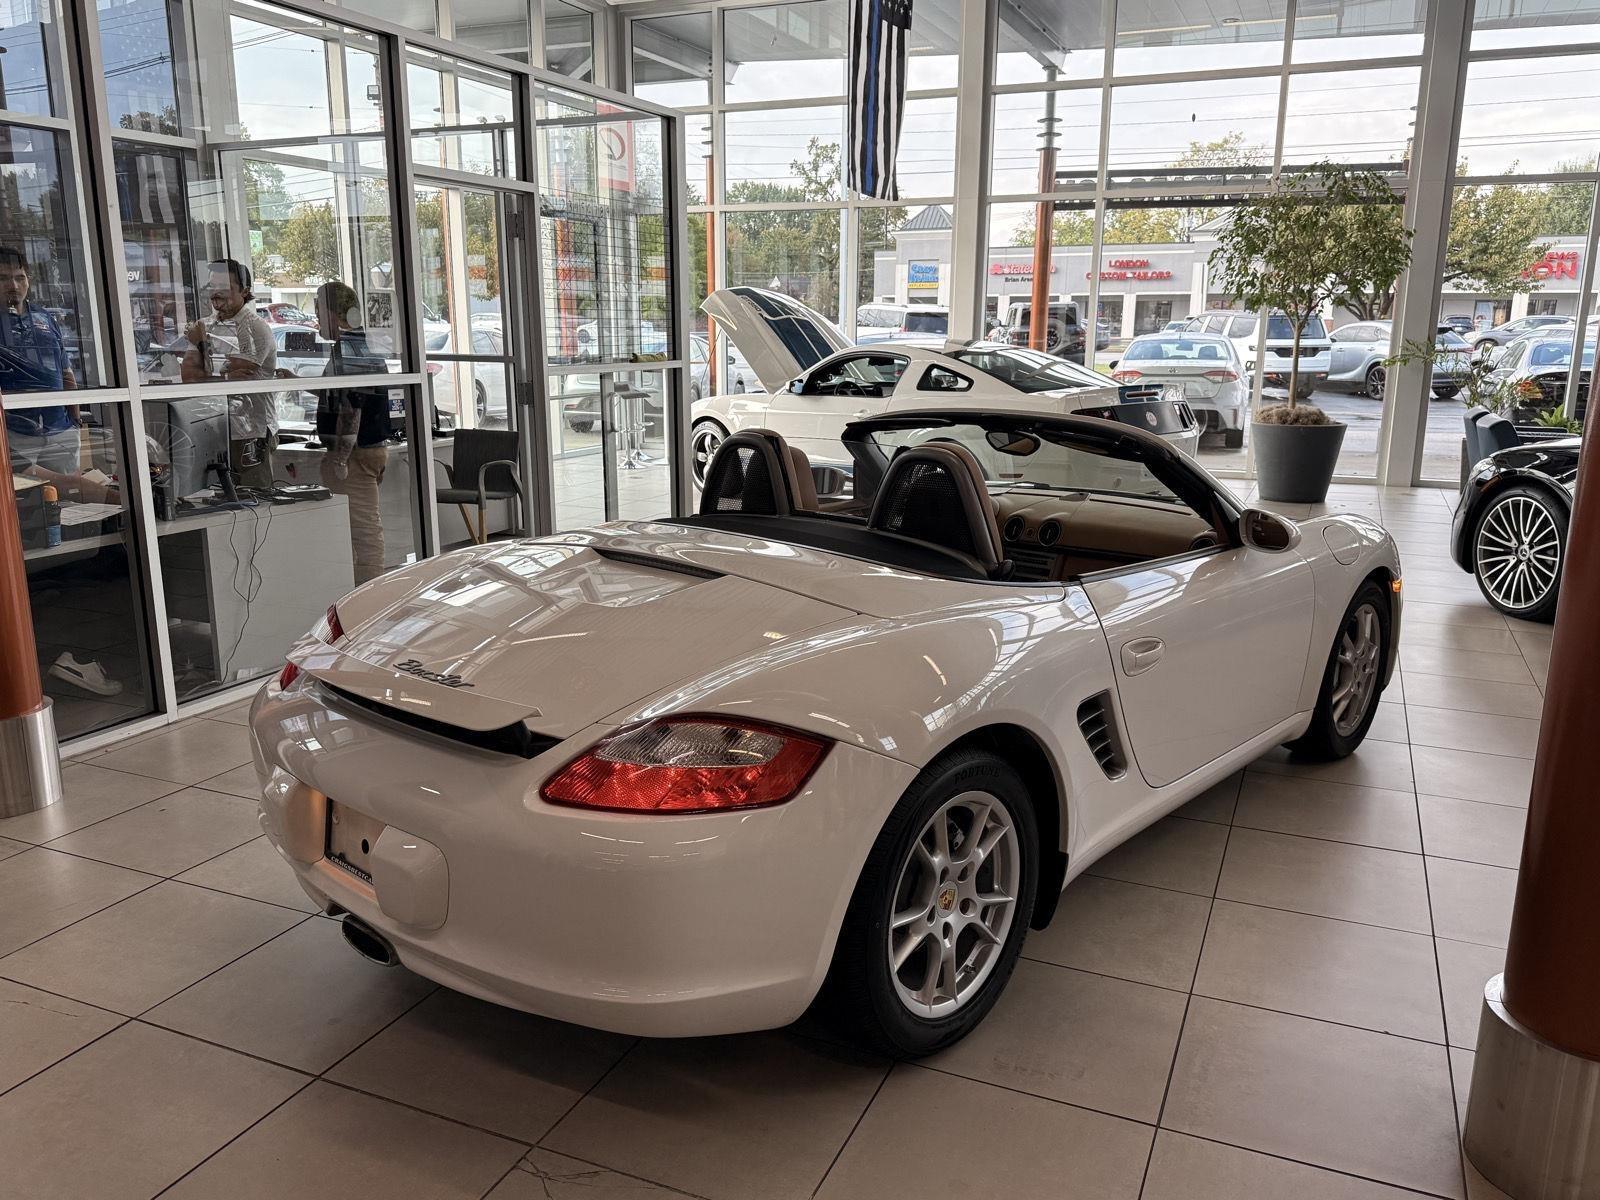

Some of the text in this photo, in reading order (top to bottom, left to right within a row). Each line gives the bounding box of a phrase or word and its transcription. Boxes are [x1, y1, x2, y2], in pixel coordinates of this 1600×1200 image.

[1109, 260, 1150, 268] LONDON
[1086, 271, 1173, 280] CSTOM TAILORS
[393, 659, 475, 688] Boxster
[331, 856, 374, 884] CRAIGSBESTCA
